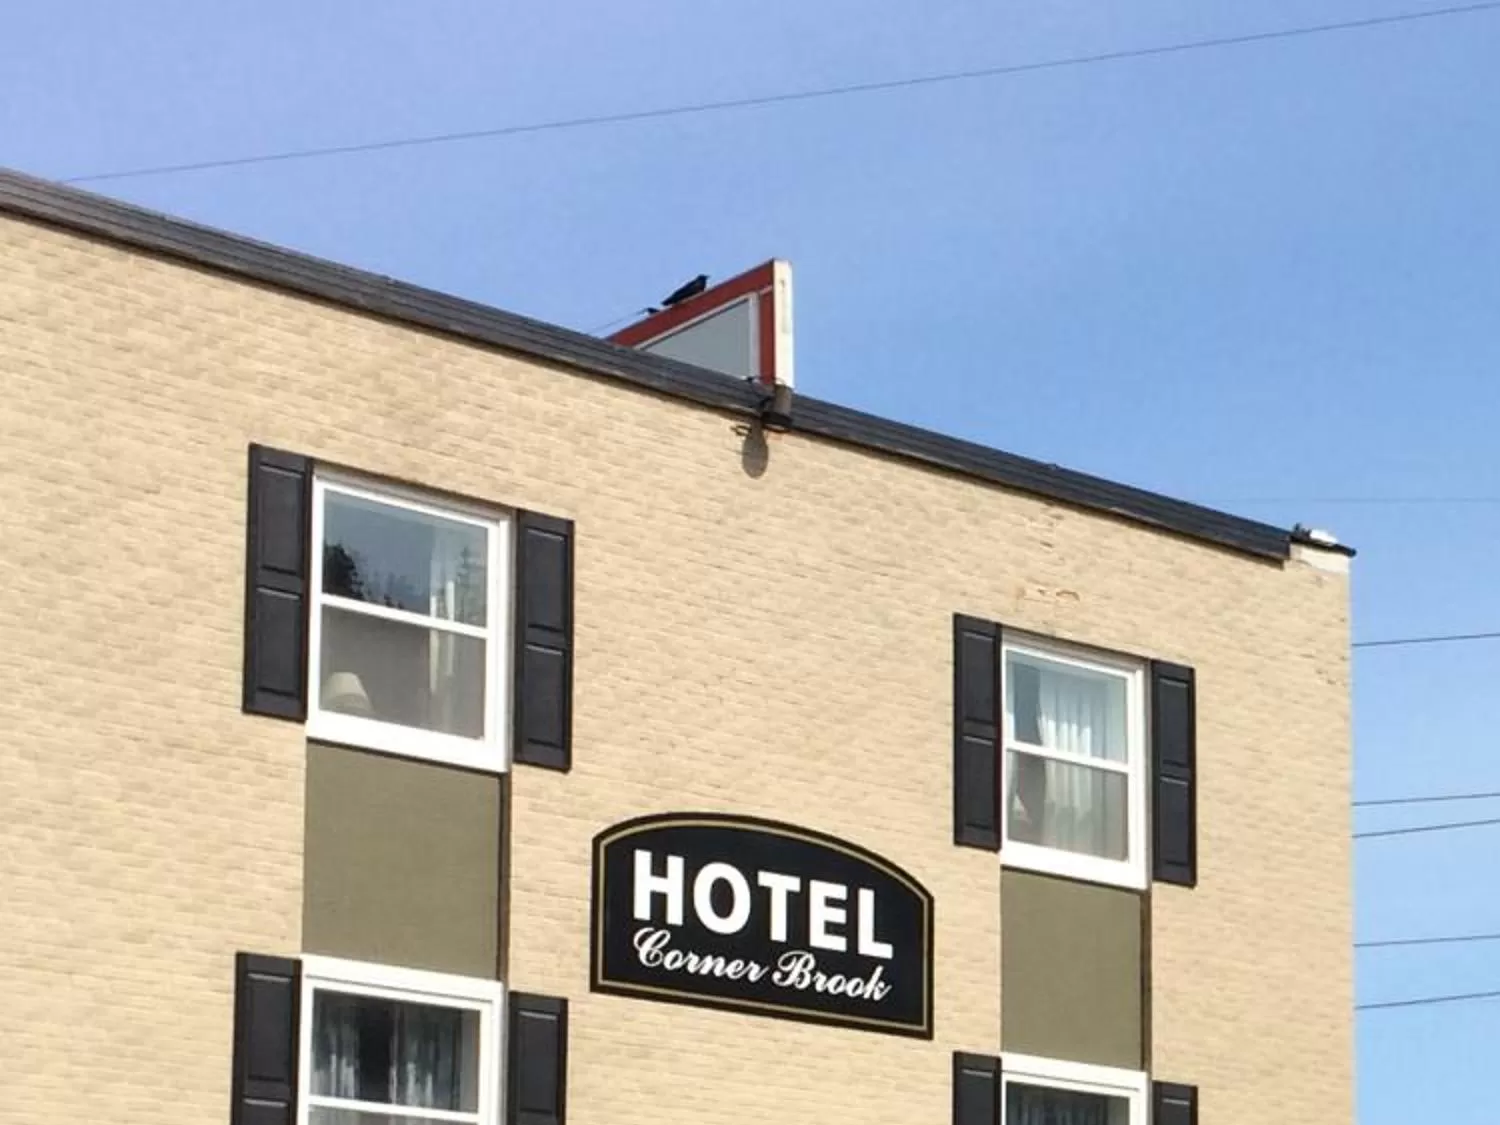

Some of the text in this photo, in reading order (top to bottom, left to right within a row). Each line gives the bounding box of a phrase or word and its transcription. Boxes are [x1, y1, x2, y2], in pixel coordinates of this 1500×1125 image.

[633, 849, 894, 960] HOTEL
[633, 927, 892, 1001] Corner Brook
